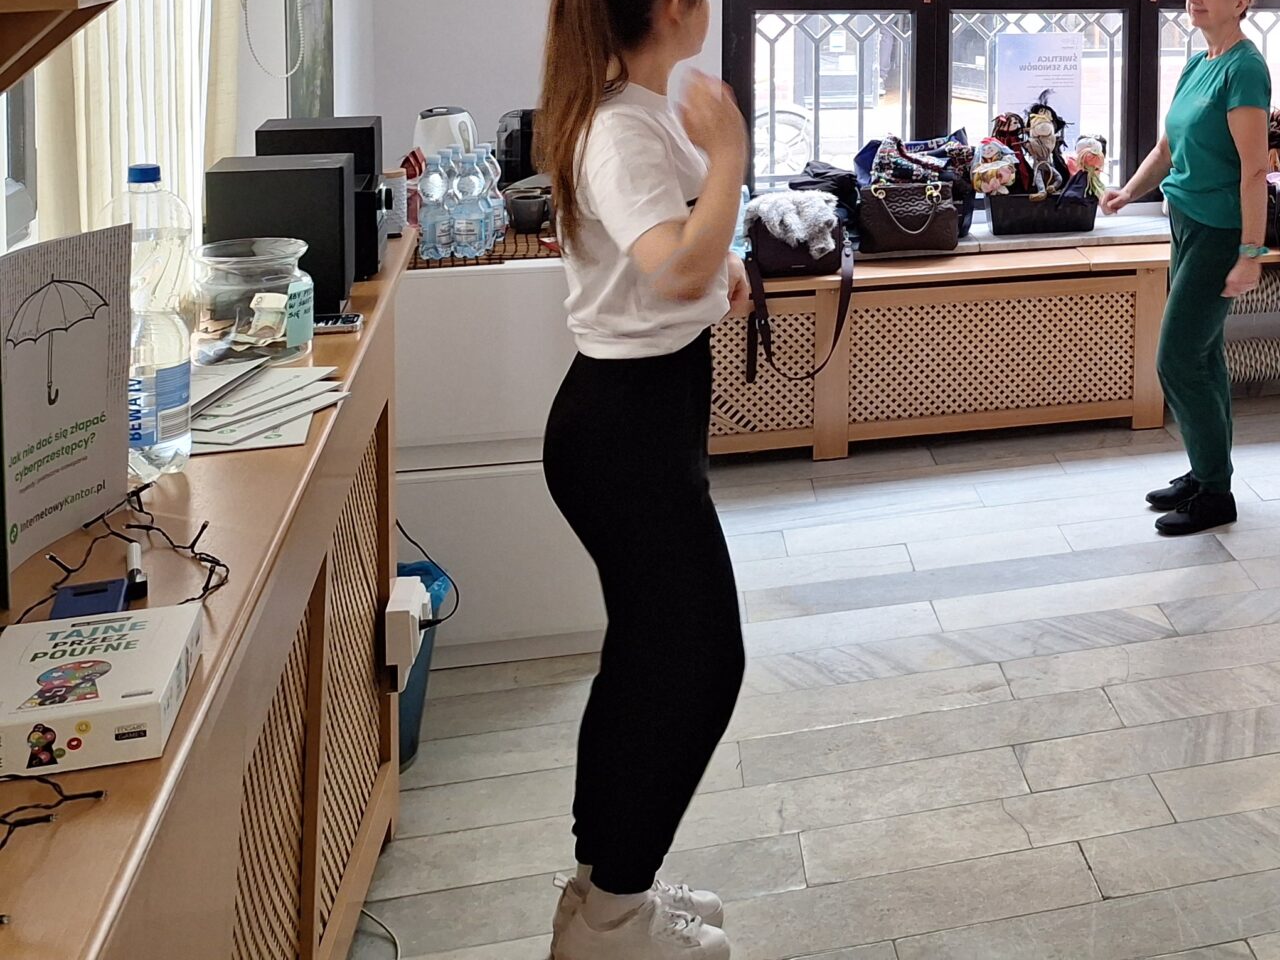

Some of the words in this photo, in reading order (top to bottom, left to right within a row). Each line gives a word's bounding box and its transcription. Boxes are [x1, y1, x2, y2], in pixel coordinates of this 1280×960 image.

[8, 450, 22, 468] Jak
[22, 443, 35, 460] nie
[36, 433, 53, 451] dać
[54, 427, 69, 441] się
[69, 411, 107, 435] złapać
[15, 432, 97, 484] cyberprzestępcy?
[20, 479, 106, 533] InternetowyKantor.pl
[46, 620, 149, 642] TAJNE
[51, 633, 129, 649] PRZEZ
[29, 639, 139, 662] POUFNE
